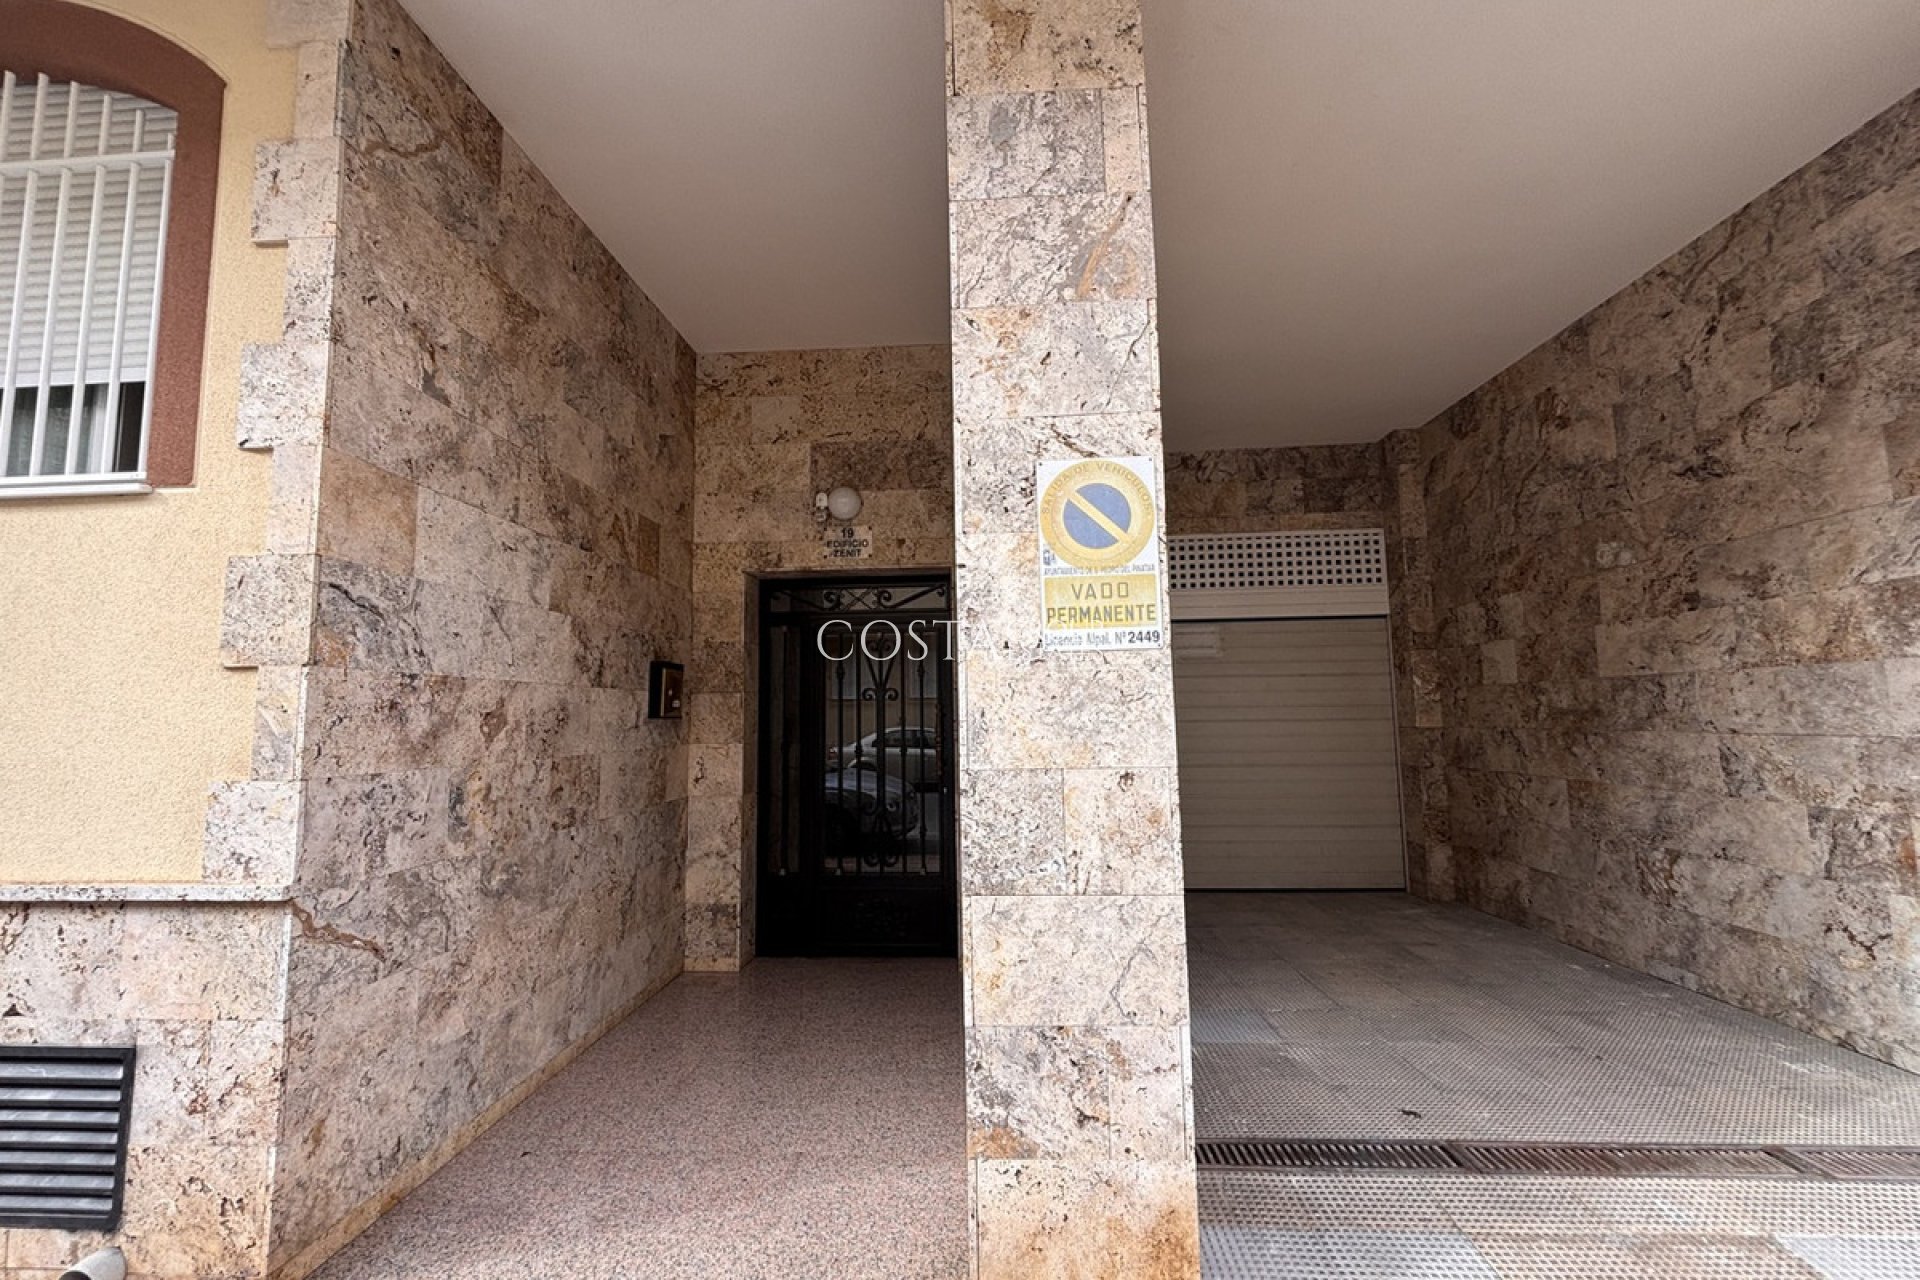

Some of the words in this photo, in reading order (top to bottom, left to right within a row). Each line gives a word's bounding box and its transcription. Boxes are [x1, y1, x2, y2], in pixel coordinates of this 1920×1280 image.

[1076, 463, 1091, 475] DE
[841, 527, 854, 538] 19
[826, 539, 869, 548] EDIFICIO
[830, 549, 861, 557] ZENIT
[1071, 582, 1129, 600] VADO
[1047, 604, 1156, 624] PERMANENTE
[1128, 630, 1160, 644] 2449
